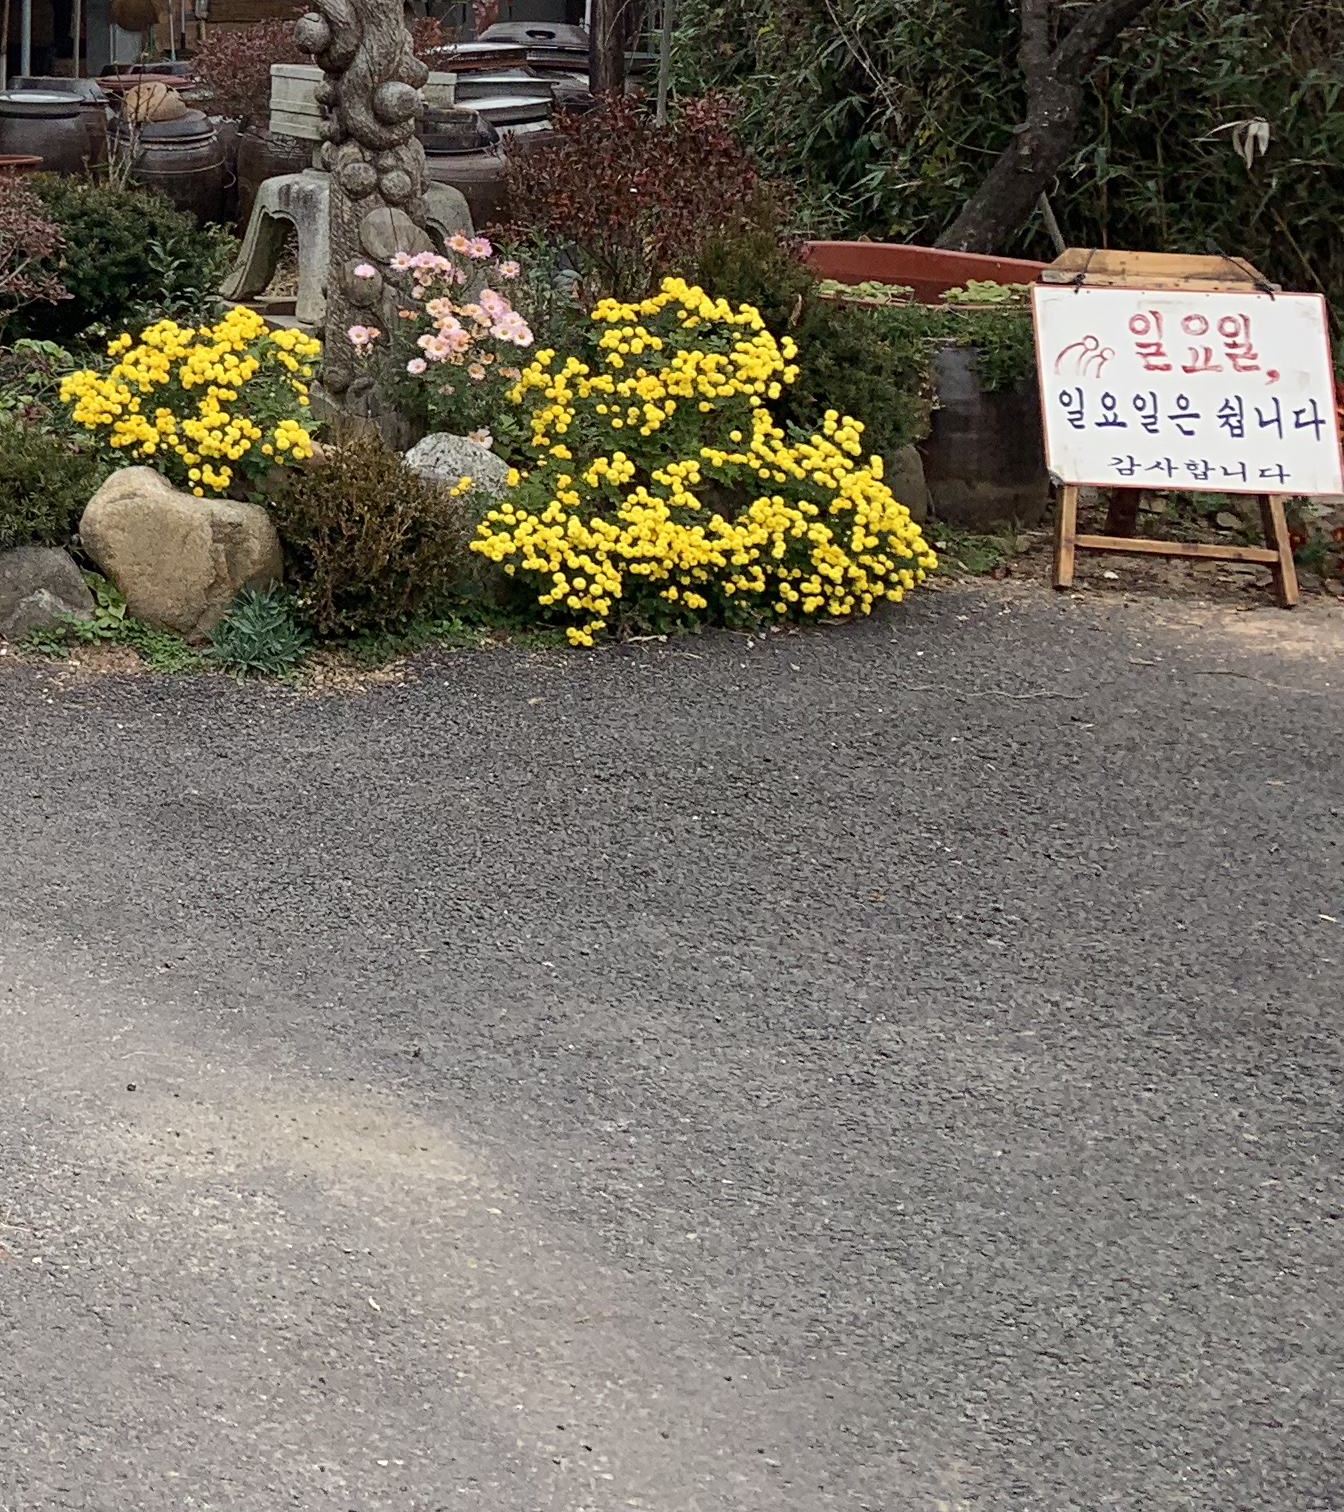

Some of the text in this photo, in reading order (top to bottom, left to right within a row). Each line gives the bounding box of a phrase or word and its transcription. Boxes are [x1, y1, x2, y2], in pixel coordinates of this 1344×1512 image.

[1059, 387, 1327, 441] 일요일은 쉽니다
[1108, 455, 1292, 485] 감사합니다
